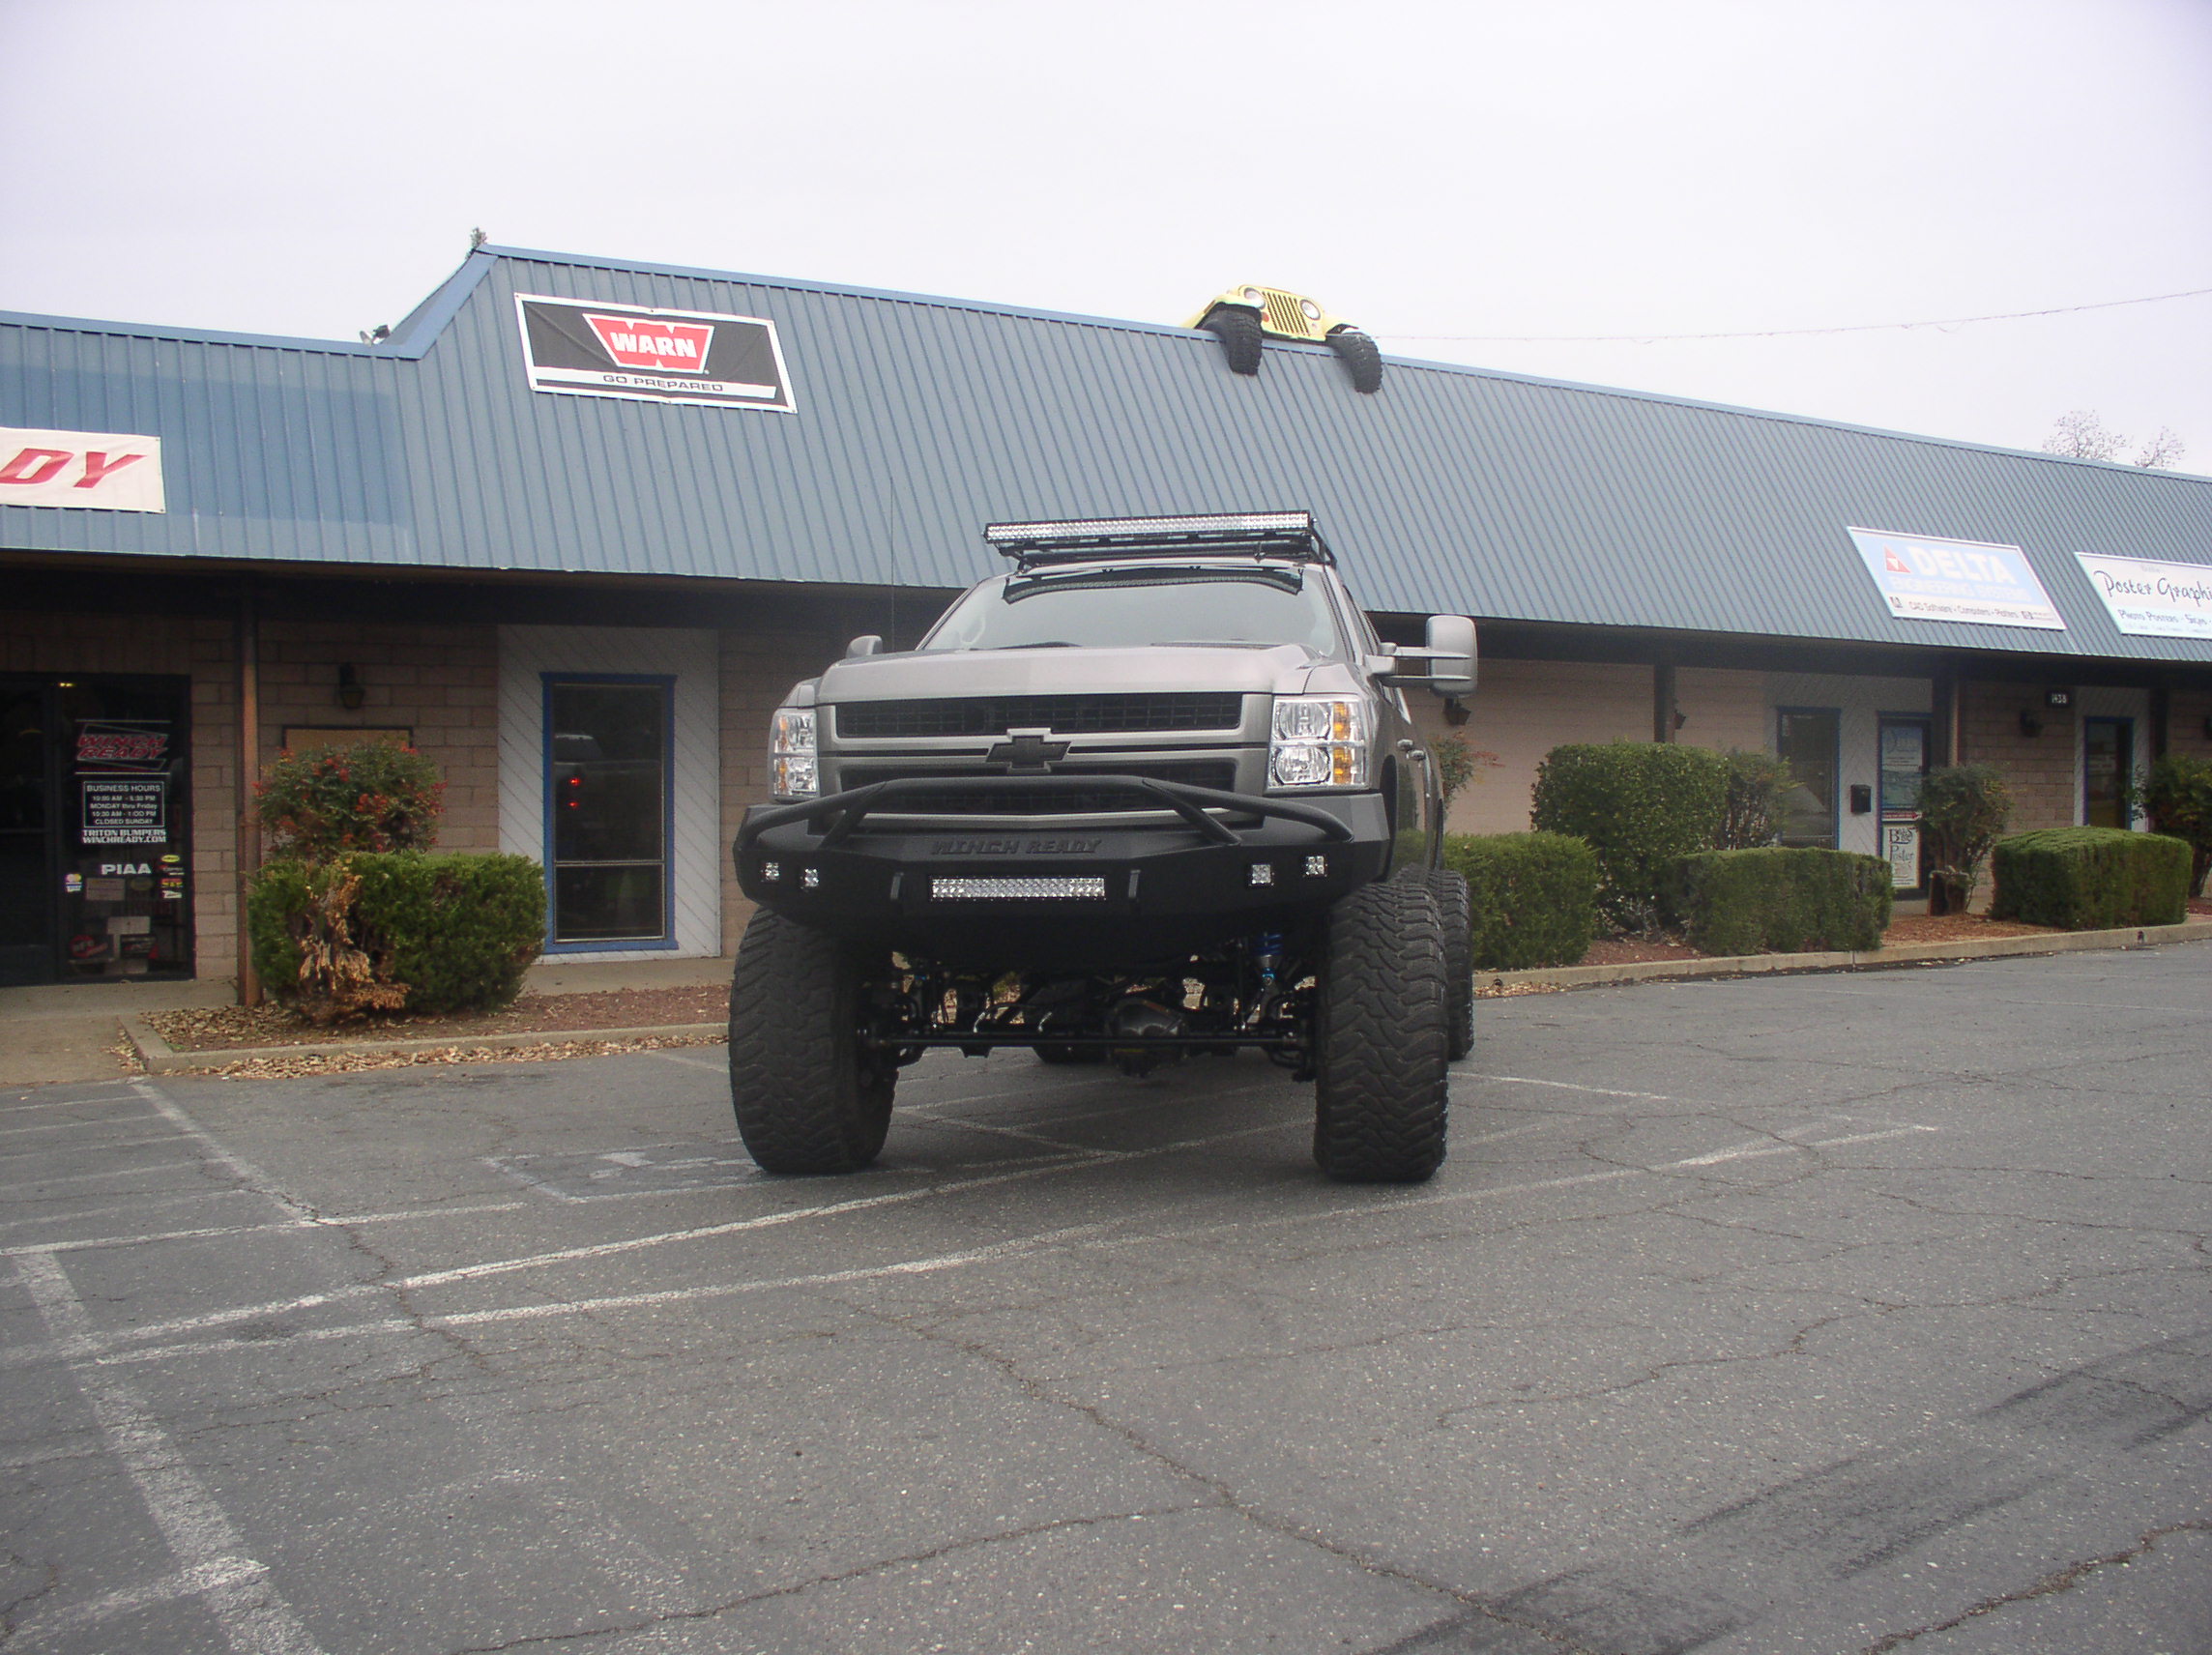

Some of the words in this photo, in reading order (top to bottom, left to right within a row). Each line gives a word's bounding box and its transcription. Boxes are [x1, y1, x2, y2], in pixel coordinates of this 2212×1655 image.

[610, 332, 697, 359] WARN
[602, 374, 628, 384] GO
[634, 377, 724, 392] PREPARED
[0, 448, 147, 489] DY
[1907, 546, 2018, 584] DELTA
[2093, 570, 2151, 597] Poster
[78, 735, 168, 747] WINCH
[77, 747, 168, 759] READY
[932, 839, 1020, 855] WINCH
[1026, 838, 1102, 855] READY
[101, 863, 152, 875] PIAA
